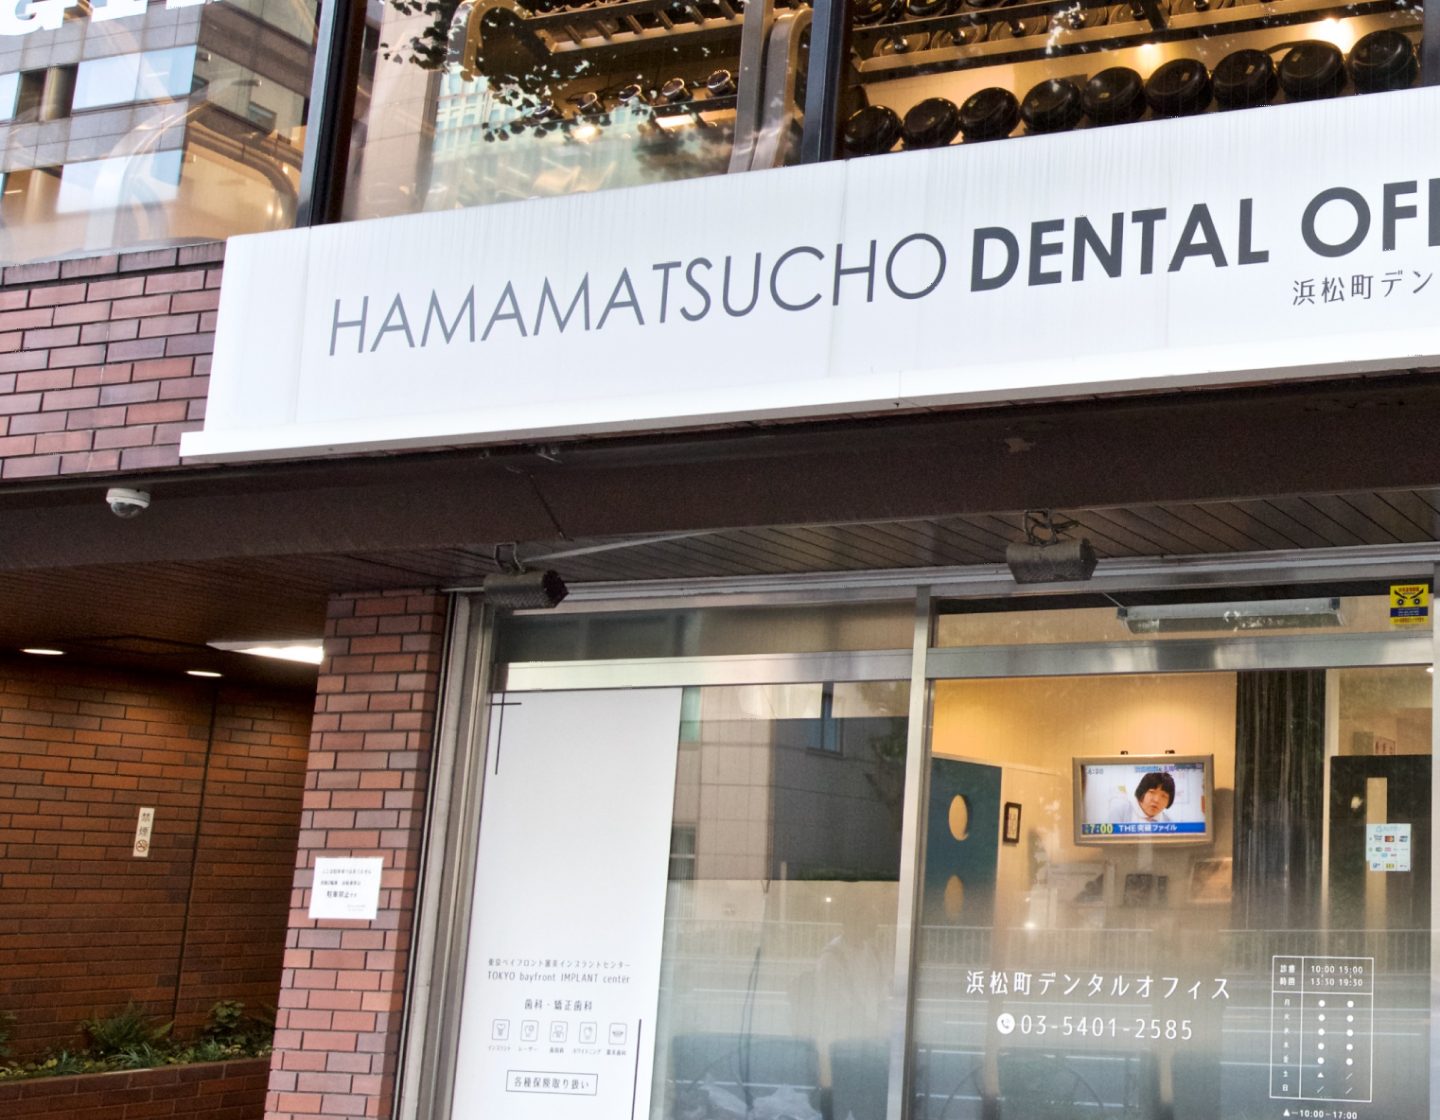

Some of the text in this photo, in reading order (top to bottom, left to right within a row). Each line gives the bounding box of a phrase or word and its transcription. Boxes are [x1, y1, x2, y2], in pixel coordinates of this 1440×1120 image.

[328, 232, 947, 356] HAMAMATSUCHO
[969, 198, 1269, 292] DENTAL
[1311, 965, 1335, 974] 10:00
[488, 970, 631, 985] TOKYO bayfront IMPLANT center
[966, 969, 1231, 1001] 浜松町デンタルオフィス
[1311, 977, 1363, 987] 13:30 19:30
[1020, 1014, 1194, 1041] 03-5401-2585
[514, 1076, 589, 1090] 各種保険取り扱い
